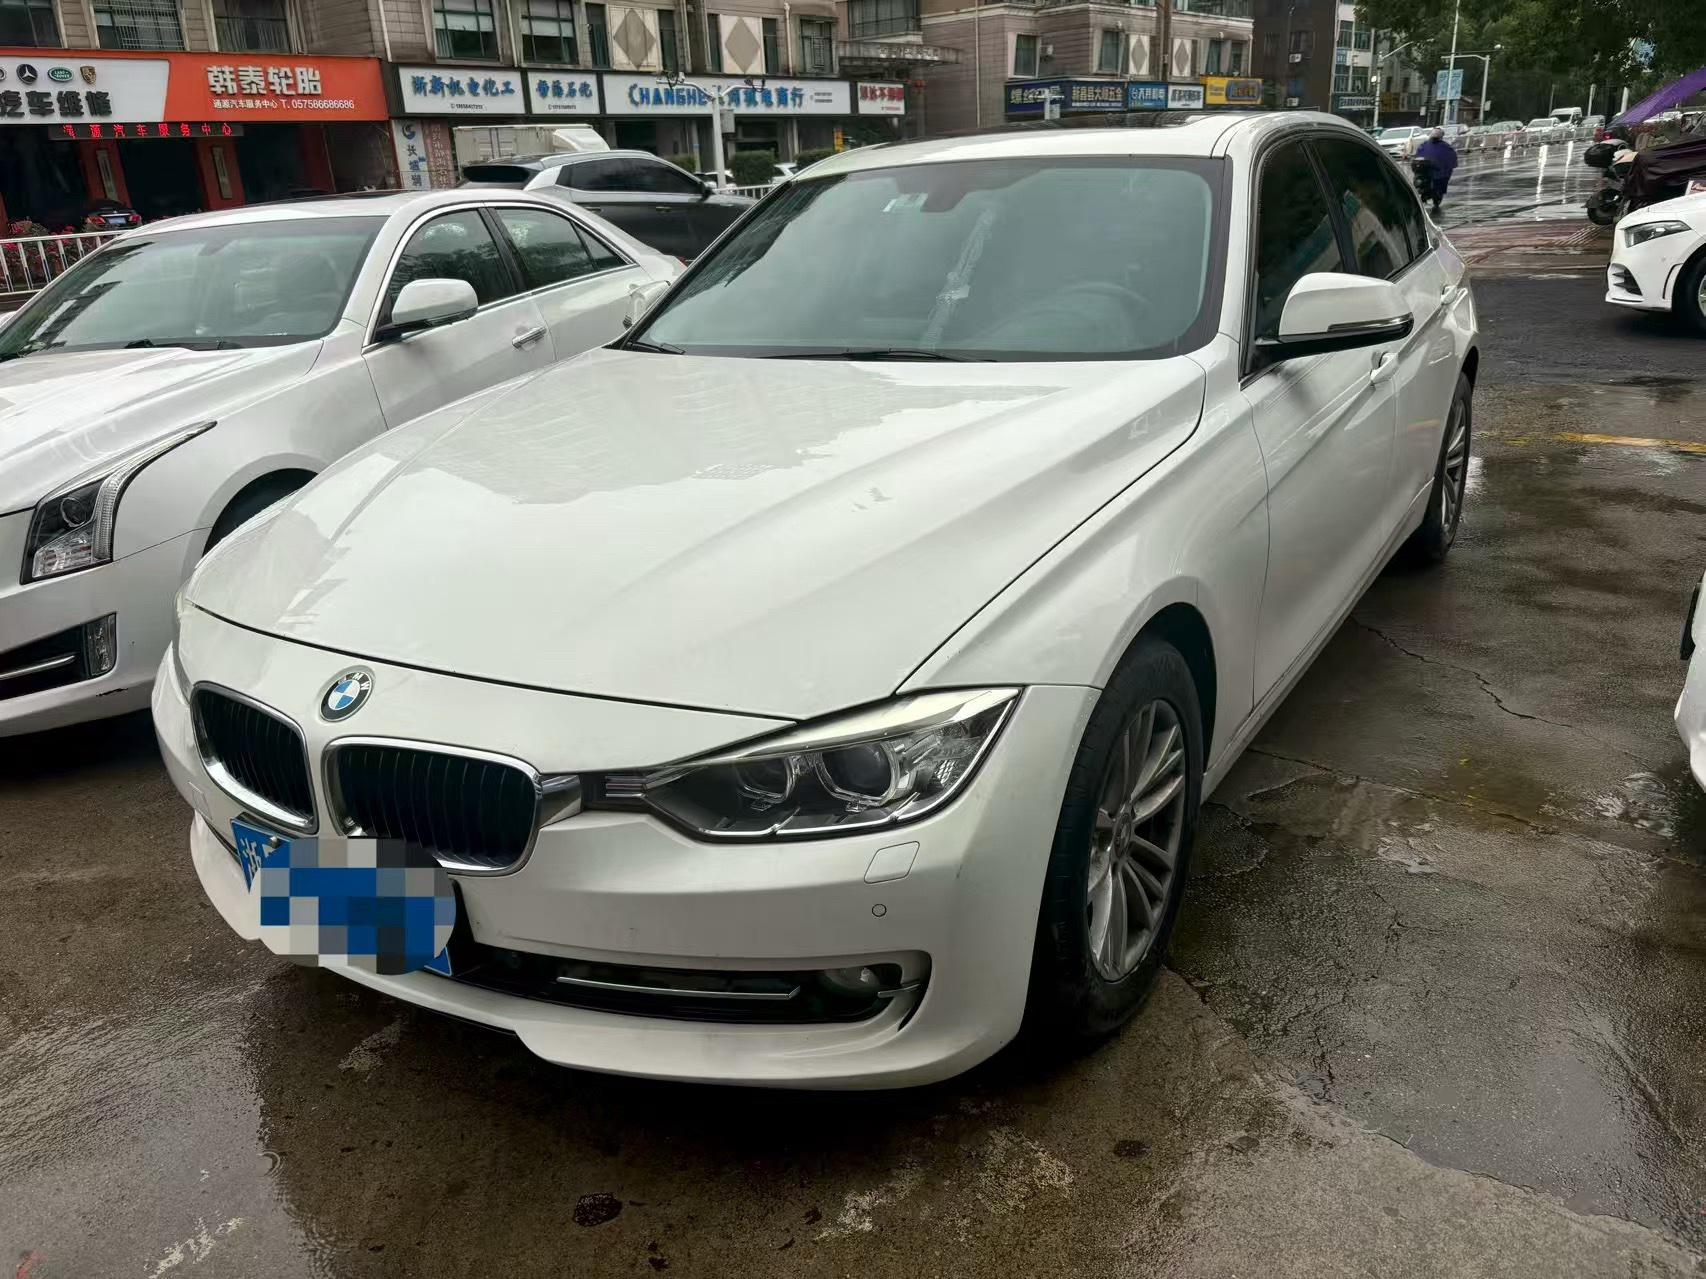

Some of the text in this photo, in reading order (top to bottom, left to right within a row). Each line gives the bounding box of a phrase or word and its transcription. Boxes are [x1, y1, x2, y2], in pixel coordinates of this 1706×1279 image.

[207, 65, 322, 95] 韩泰轮胎
[0, 90, 112, 117] 汽车维修
[213, 99, 279, 109] 通源汽车服务中心
[291, 99, 355, 109] 057586686686
[628, 83, 708, 107] CHANGHE
